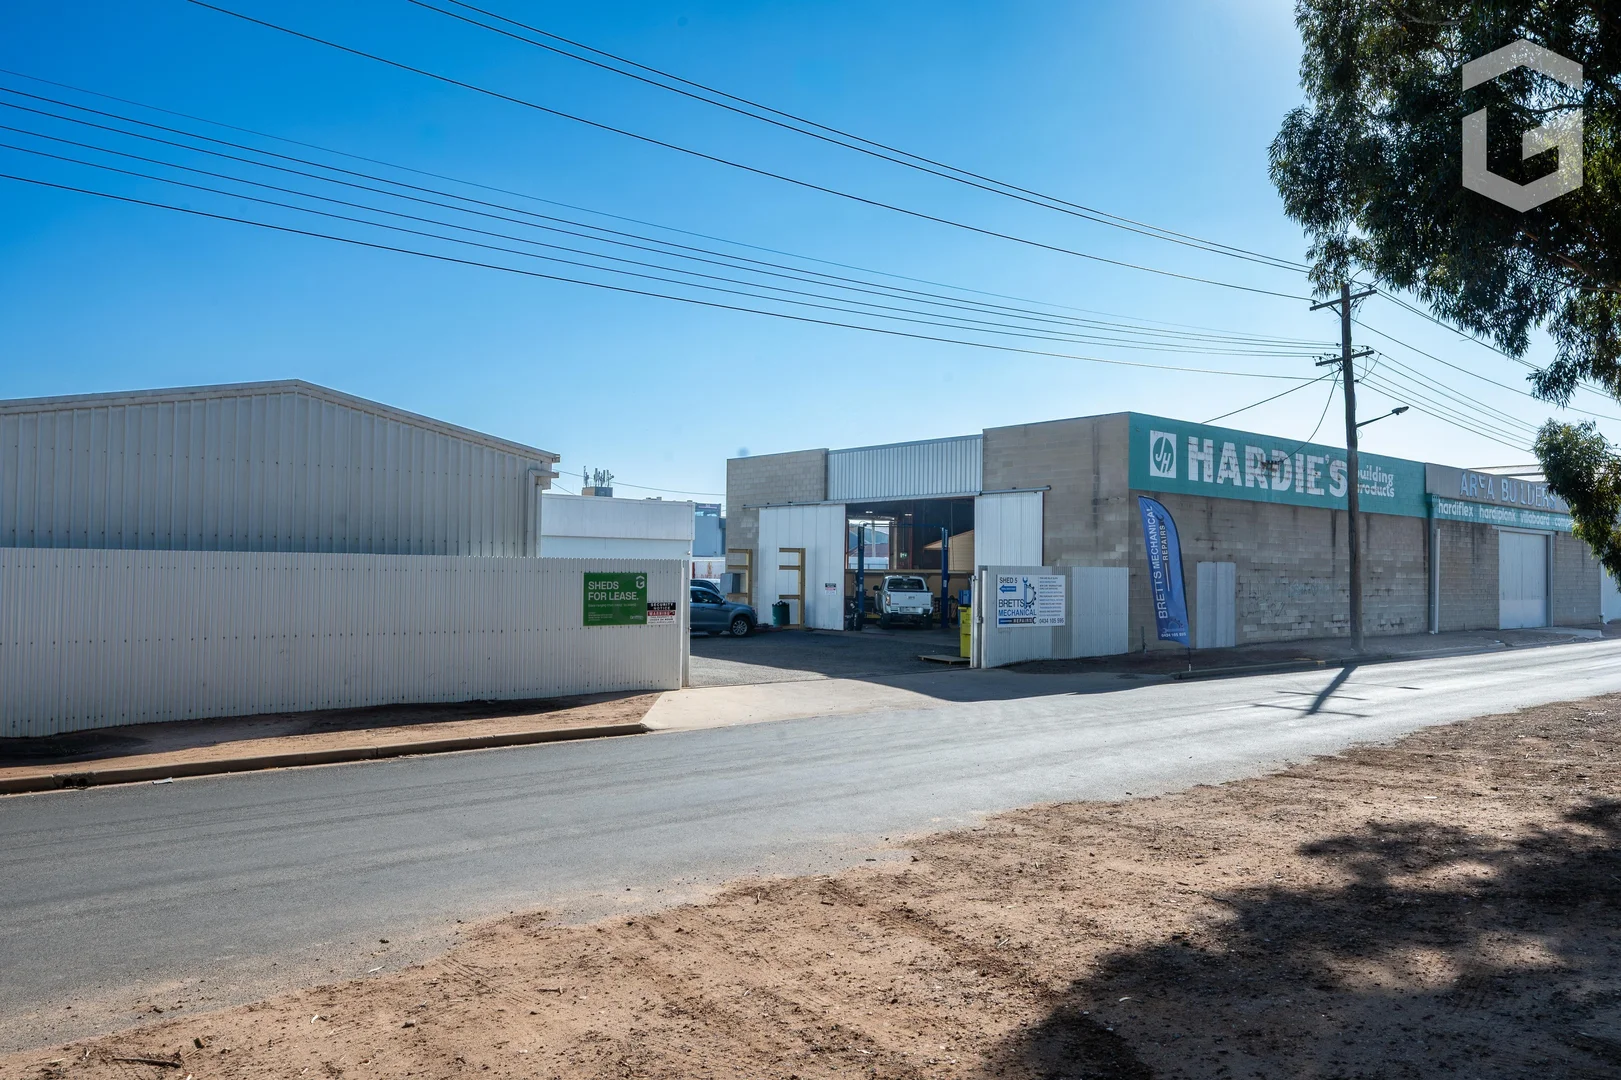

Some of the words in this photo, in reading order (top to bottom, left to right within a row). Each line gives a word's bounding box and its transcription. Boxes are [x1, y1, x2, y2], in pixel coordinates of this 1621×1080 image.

[1187, 435, 1349, 498] HARDIE'S
[1438, 498, 1474, 518] hardiflex
[1479, 504, 1516, 523] hardiplank
[1146, 506, 1160, 569] MECHANICAL
[1158, 524, 1169, 561] REPAIRS
[588, 581, 619, 590] SHEDS
[588, 591, 607, 601] FOR
[608, 592, 639, 600] LEASE.
[1153, 571, 1169, 619] BRETTS
[998, 599, 1024, 608] BRETTS
[998, 609, 1037, 617] MECHANICAL
